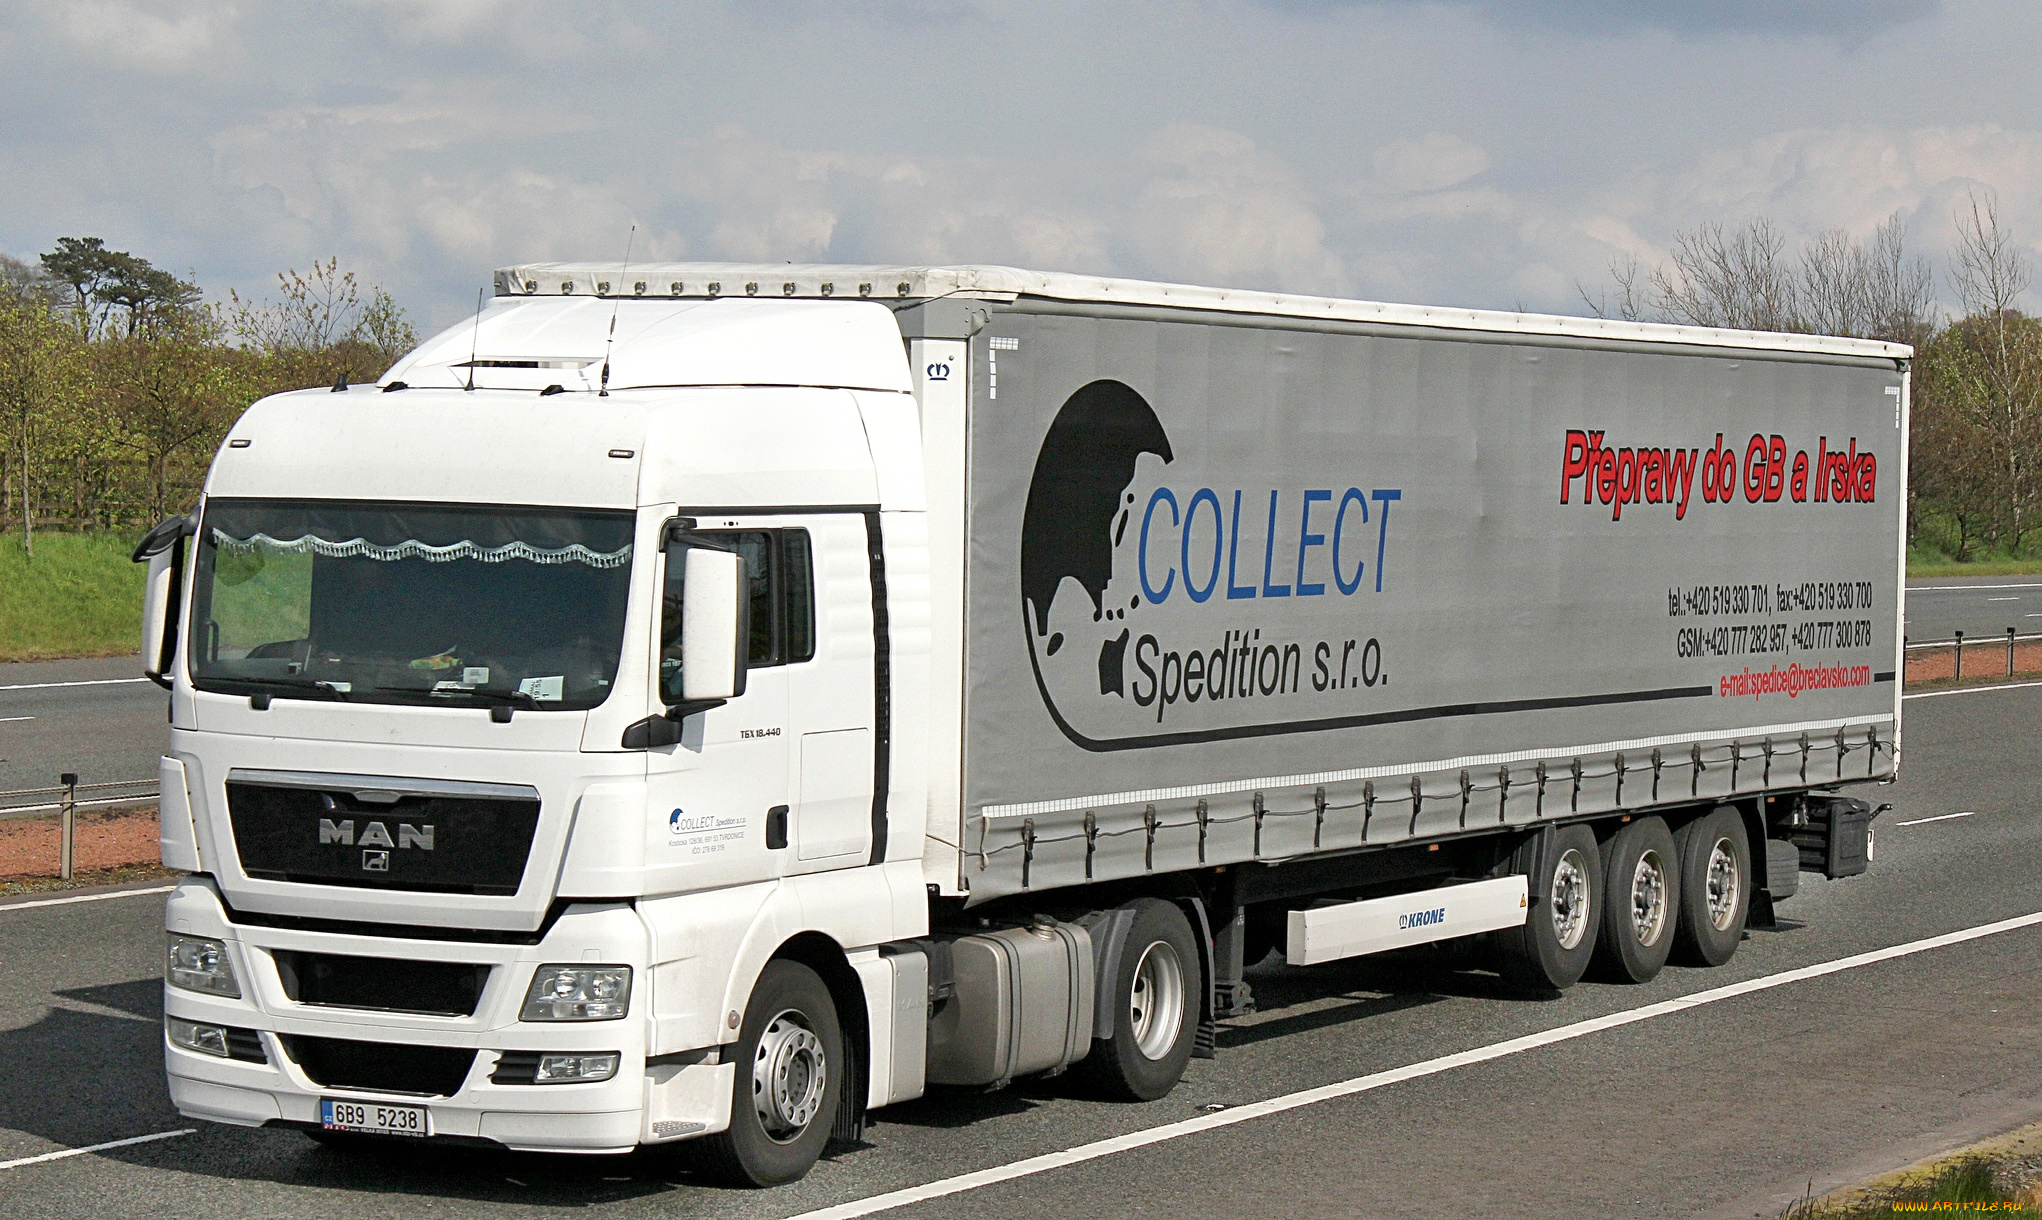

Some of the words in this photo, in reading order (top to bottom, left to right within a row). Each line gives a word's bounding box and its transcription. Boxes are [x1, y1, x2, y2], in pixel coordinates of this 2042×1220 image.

[1560, 429, 1699, 521] Přepravy
[1702, 432, 1736, 504] do
[1743, 433, 1787, 503] GB
[1790, 449, 1809, 504] a
[1813, 436, 1877, 504] Irska
[1138, 487, 1402, 605] COLLECT
[1712, 585, 1731, 615] 519
[1732, 585, 1749, 614] 330
[1752, 584, 1772, 617] 701,
[1818, 582, 1835, 610] 519
[1837, 581, 1854, 609] 330
[1856, 581, 1872, 609] 700
[1677, 627, 1729, 658] GSM:+420
[1731, 625, 1748, 655] 777
[1750, 624, 1767, 653] 282
[1769, 623, 1789, 655] 957,
[1792, 622, 1814, 650] +420
[1817, 621, 1834, 649] 777
[1836, 621, 1851, 648] 300
[1854, 620, 1871, 647] 878
[1132, 628, 1301, 723] Spedition
[1311, 637, 1388, 692] s.r.o.
[1720, 661, 1870, 701] e-mail:spedice@breclavsko.com
[756, 727, 781, 738] 18.440
[319, 818, 434, 850] MAN
[681, 816, 714, 830] COLLECT
[1407, 907, 1446, 929] KRONE
[336, 1104, 365, 1125] 6B9
[377, 1108, 418, 1129] 5238
